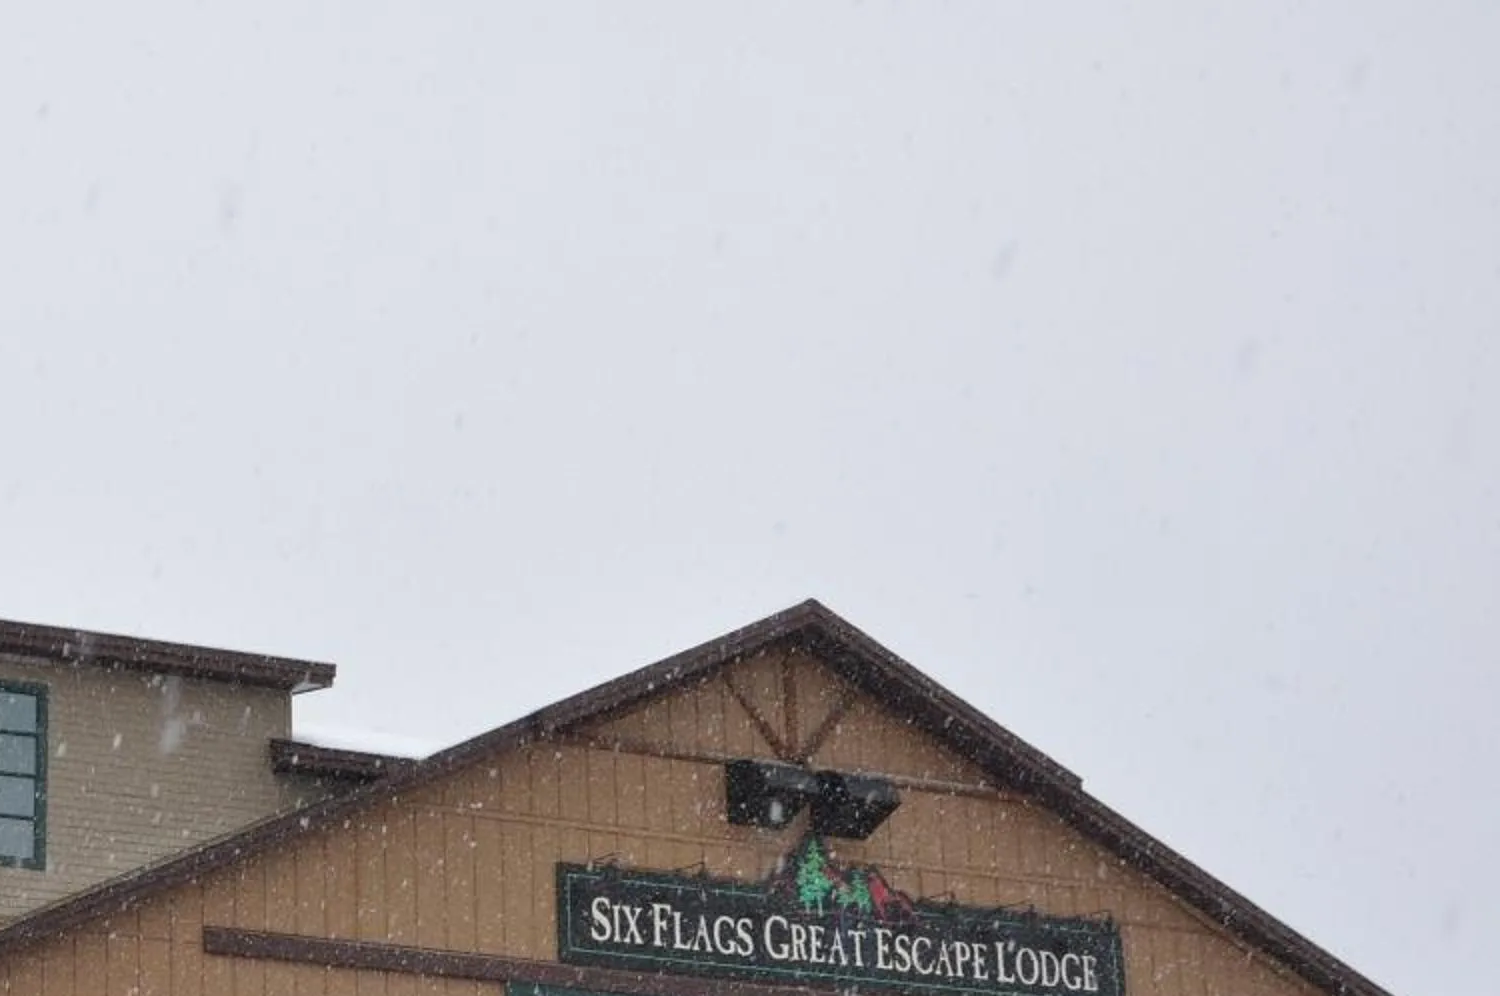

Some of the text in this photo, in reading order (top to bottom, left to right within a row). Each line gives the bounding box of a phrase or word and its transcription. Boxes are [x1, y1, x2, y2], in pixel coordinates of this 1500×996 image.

[591, 896, 1099, 991] SIX FLAGS GREAT ESCAPE LODGE
